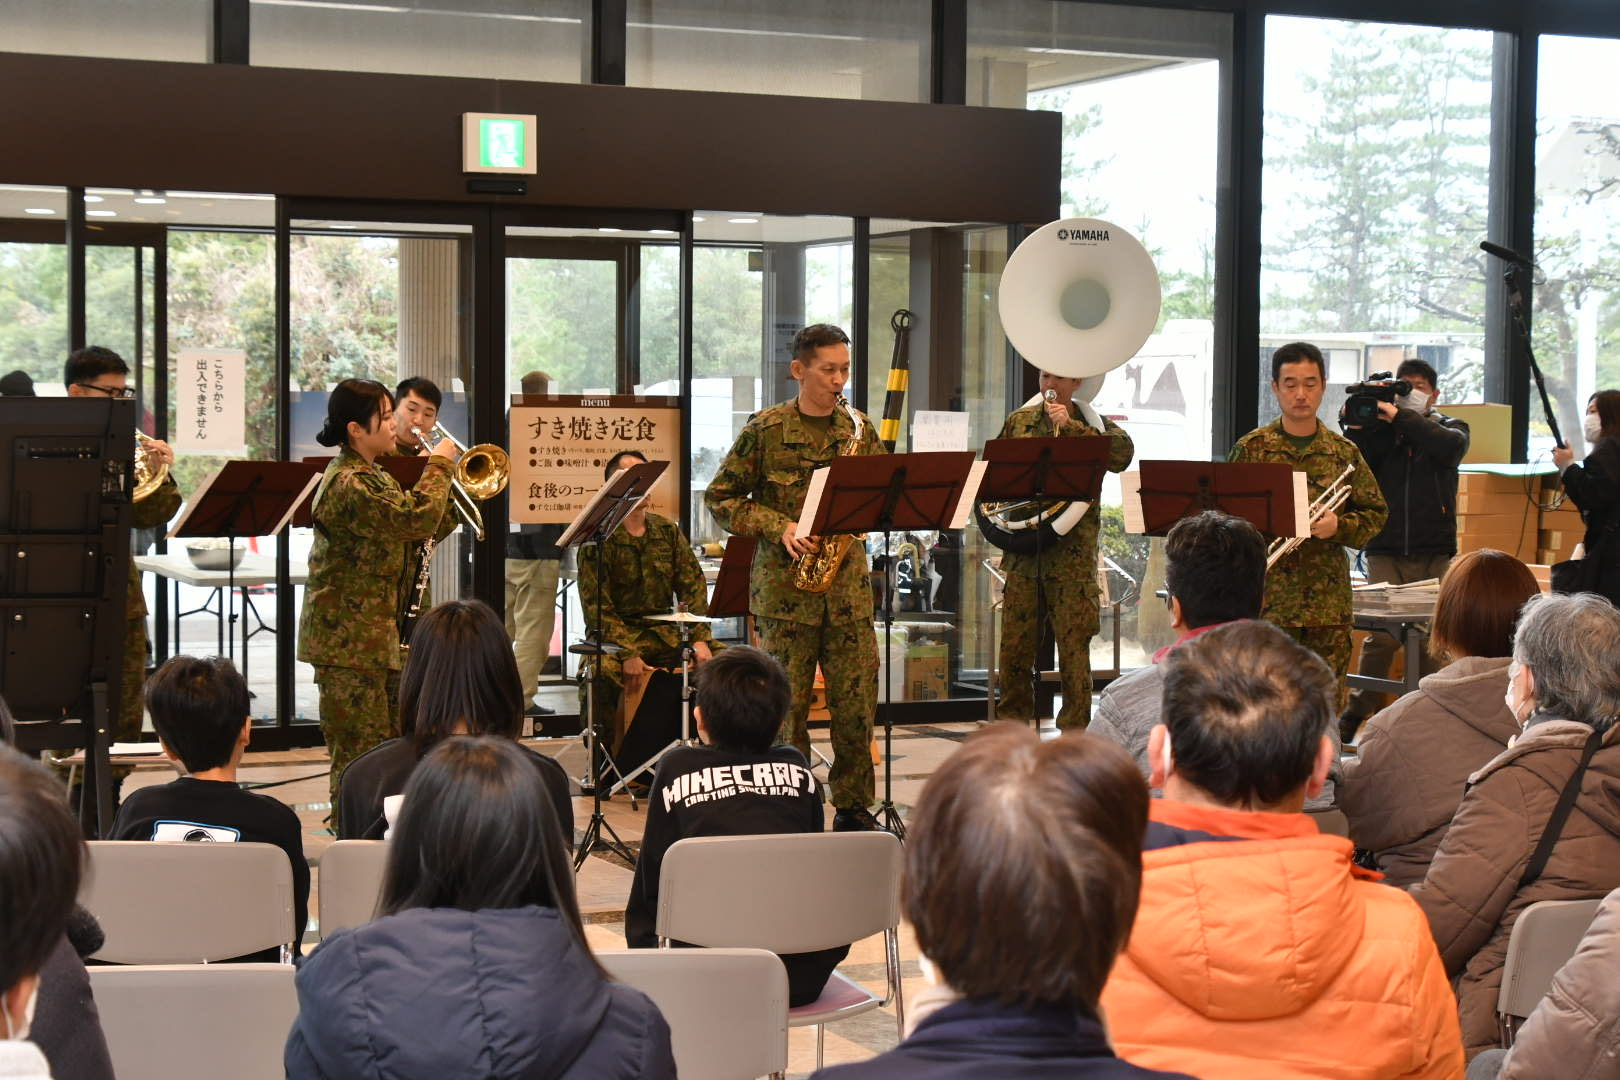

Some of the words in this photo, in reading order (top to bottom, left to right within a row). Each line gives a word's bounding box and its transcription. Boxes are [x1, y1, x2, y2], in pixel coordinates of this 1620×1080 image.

[1070, 229, 1110, 241] YAMAHA
[214, 359, 224, 413] こちらから
[196, 359, 207, 440] 出入できません
[580, 398, 610, 407] menu
[527, 416, 656, 441] すき焼き定食
[529, 482, 604, 499] 食後のコー
[662, 763, 815, 813] MINECRAFT
[684, 786, 736, 808] CRAFTING
[738, 785, 767, 796] SINCE
[770, 786, 800, 797] ALPHA
